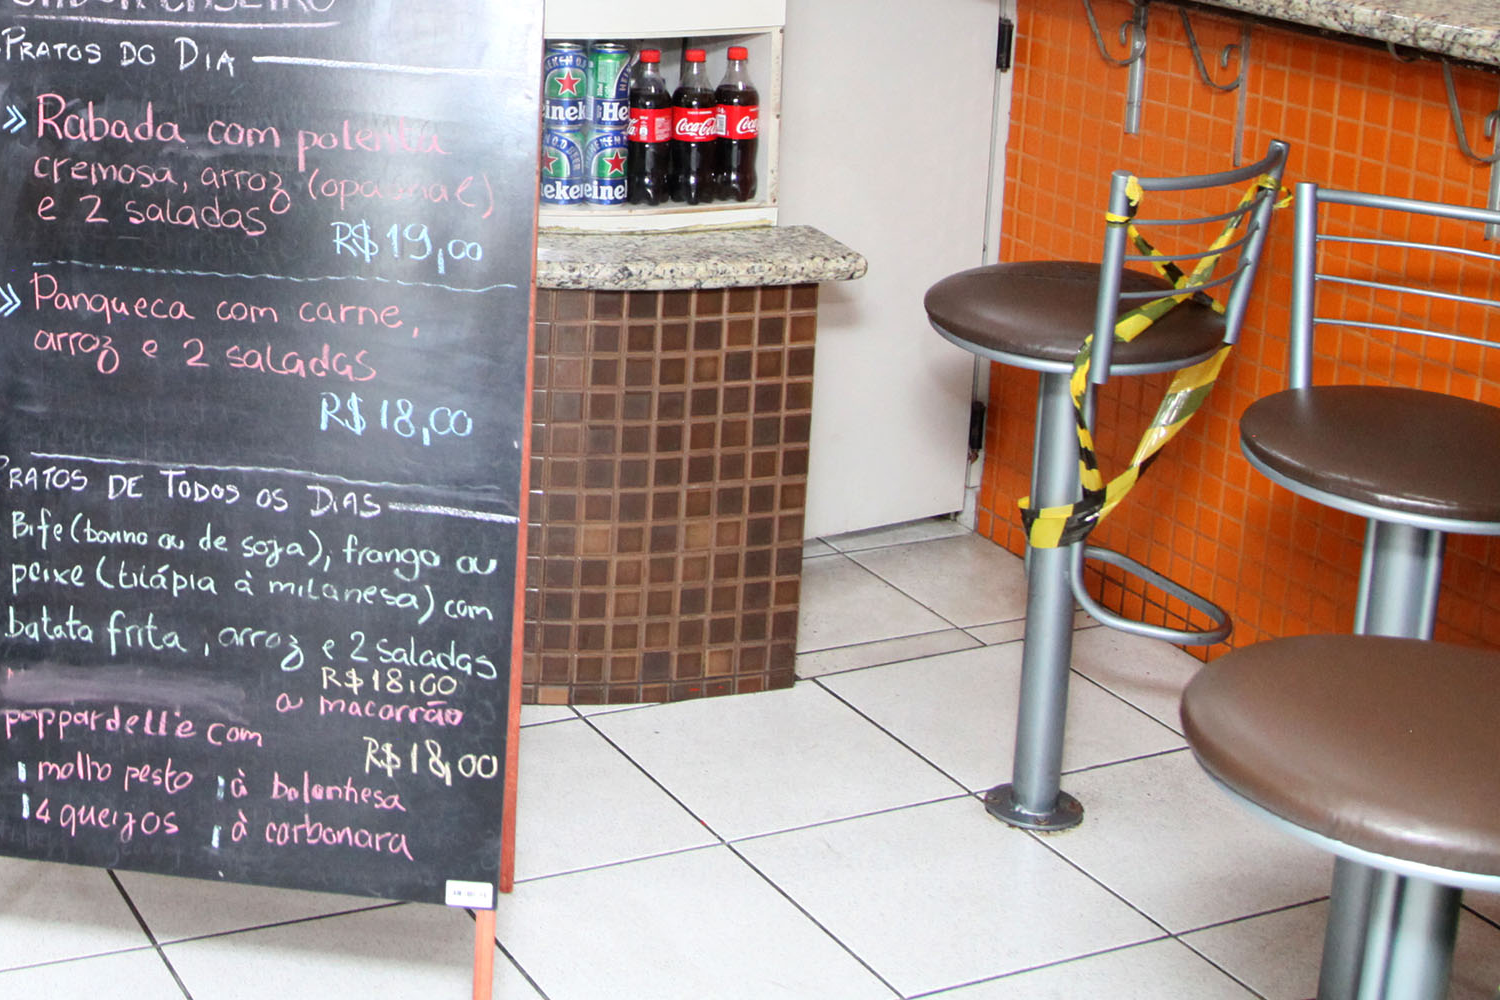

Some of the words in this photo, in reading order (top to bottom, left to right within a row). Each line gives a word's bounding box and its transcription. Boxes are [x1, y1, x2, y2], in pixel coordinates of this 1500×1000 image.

[120, 41, 155, 67] DO
[36, 93, 186, 144] Rabada
[207, 119, 281, 149] com
[200, 166, 292, 215] arroz
[37, 196, 57, 221] e
[79, 194, 109, 223] 2
[124, 195, 267, 237] saladas
[30, 272, 196, 325] Panqueca
[216, 300, 279, 324] com
[33, 329, 120, 375] arroz
[142, 339, 159, 358] e
[183, 338, 211, 367] 2
[226, 342, 377, 382] saladas
[108, 474, 144, 501] DE
[256, 487, 289, 513] OS
[199, 522, 228, 552] de
[342, 534, 441, 582] frango
[456, 555, 498, 575] ou
[11, 561, 85, 596] peixe
[444, 599, 493, 621] com
[4, 604, 94, 644] batata
[218, 627, 305, 672] arroz
[322, 639, 336, 660] e
[350, 631, 369, 662] 2
[320, 695, 464, 727] macarrão
[38, 751, 113, 782] molho
[124, 757, 194, 795] pesto
[35, 798, 51, 825] 4
[59, 803, 180, 844] queijos
[265, 813, 415, 862] carbonara
